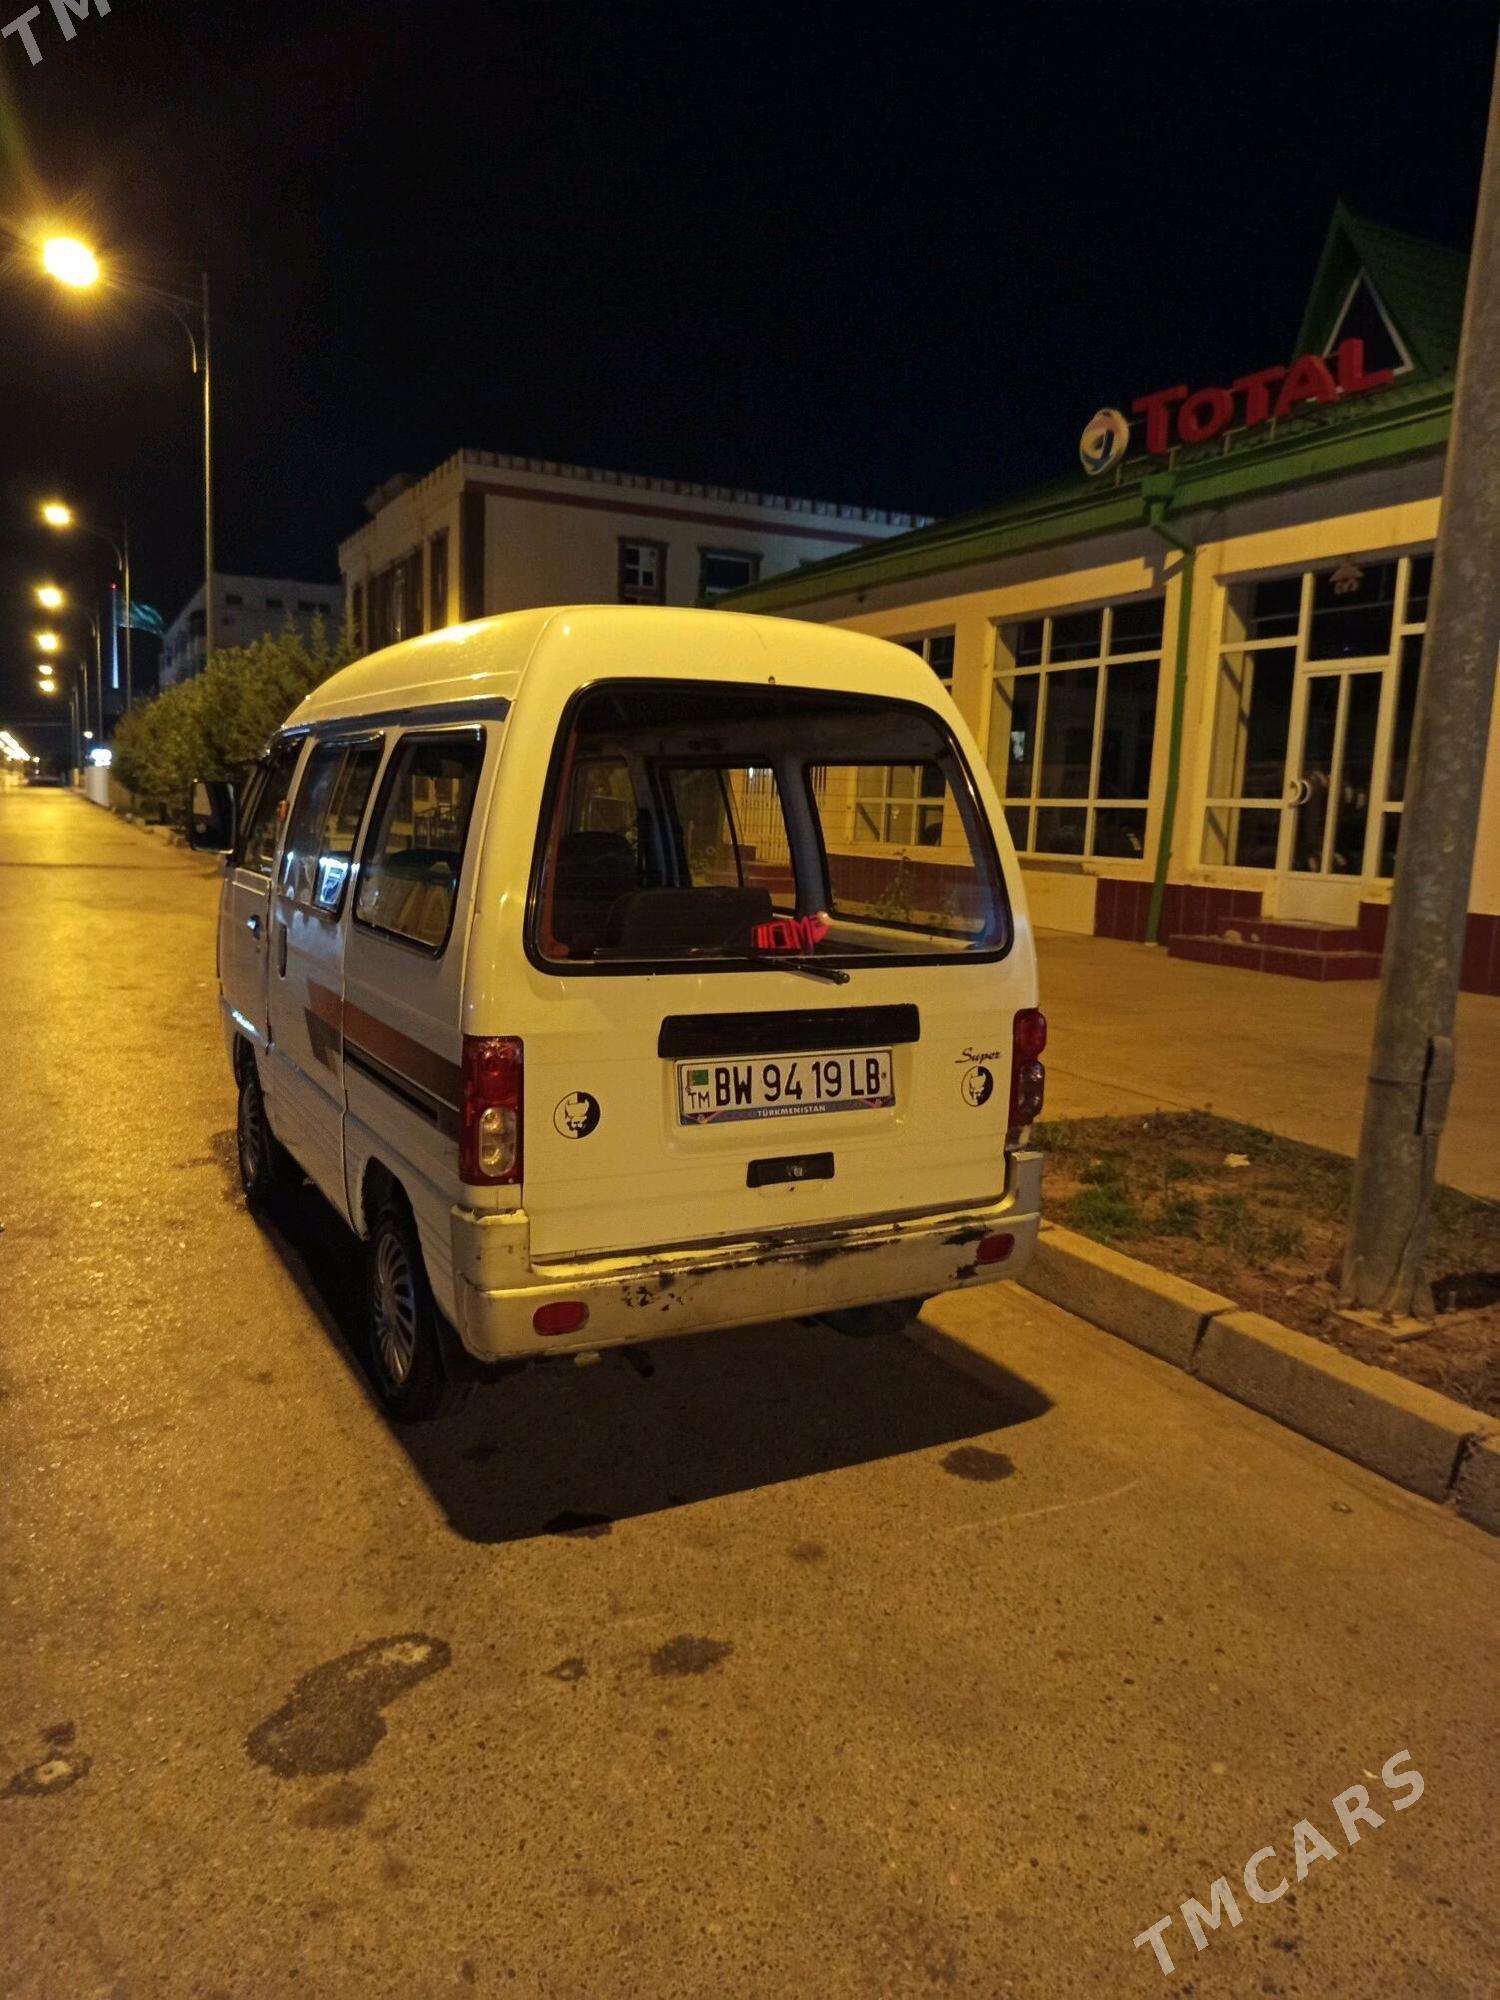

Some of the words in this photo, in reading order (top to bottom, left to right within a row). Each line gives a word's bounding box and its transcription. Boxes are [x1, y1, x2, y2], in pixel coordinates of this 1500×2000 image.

[1132, 338, 1395, 455] TOTAL
[954, 1046, 1001, 1064] Super
[715, 1066, 752, 1107] BW
[762, 1061, 803, 1102] 94
[811, 1060, 842, 1098] 19
[850, 1057, 881, 1096] LB
[688, 1091, 710, 1109] TM
[757, 1104, 826, 1117] TÜRKMENISTAN
